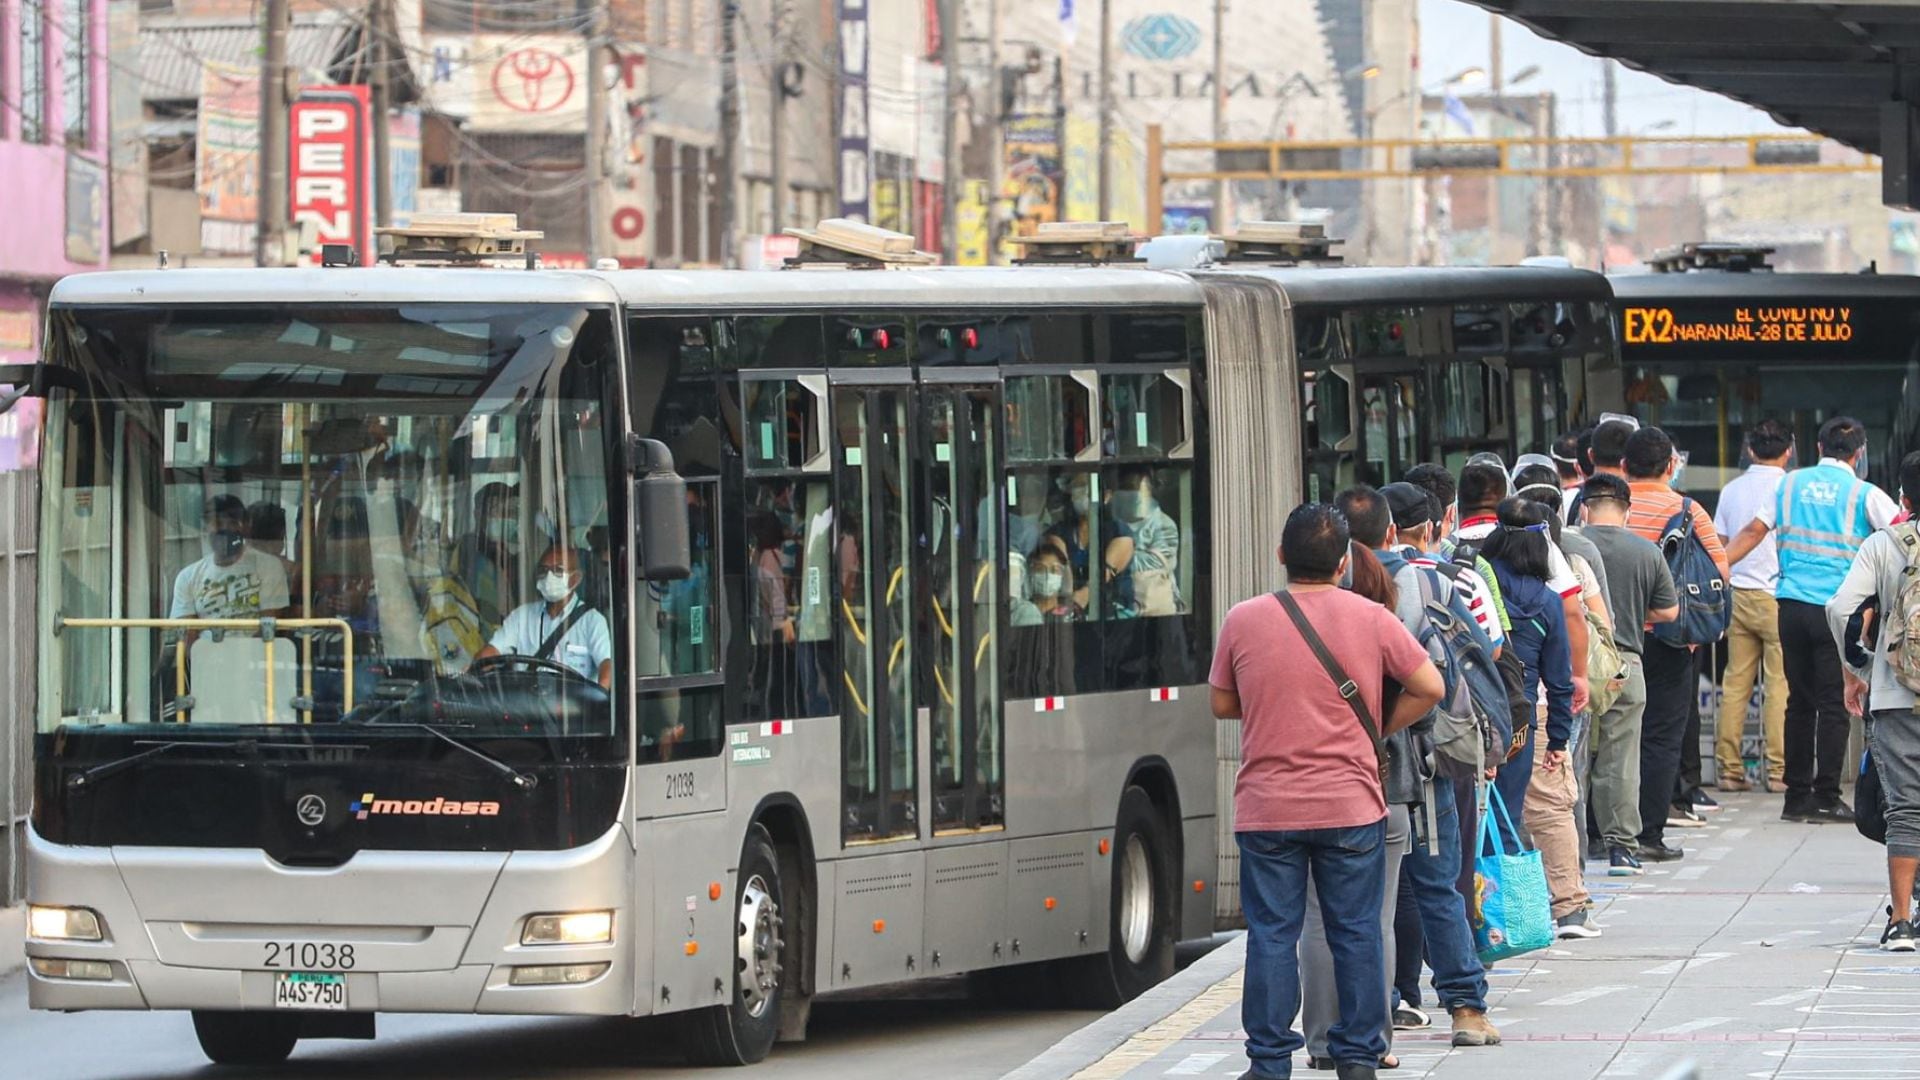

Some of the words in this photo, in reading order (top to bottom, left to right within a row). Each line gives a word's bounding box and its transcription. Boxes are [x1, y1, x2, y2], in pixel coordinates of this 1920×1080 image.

[294, 108, 352, 266] PERN
[1625, 307, 1673, 343] EX2
[1785, 323, 1806, 341] DE
[1811, 323, 1851, 341] JULIO
[665, 772, 695, 799] 21038
[371, 797, 500, 816] modasa
[263, 942, 355, 969] 21038
[279, 982, 343, 1004] A4S-750
